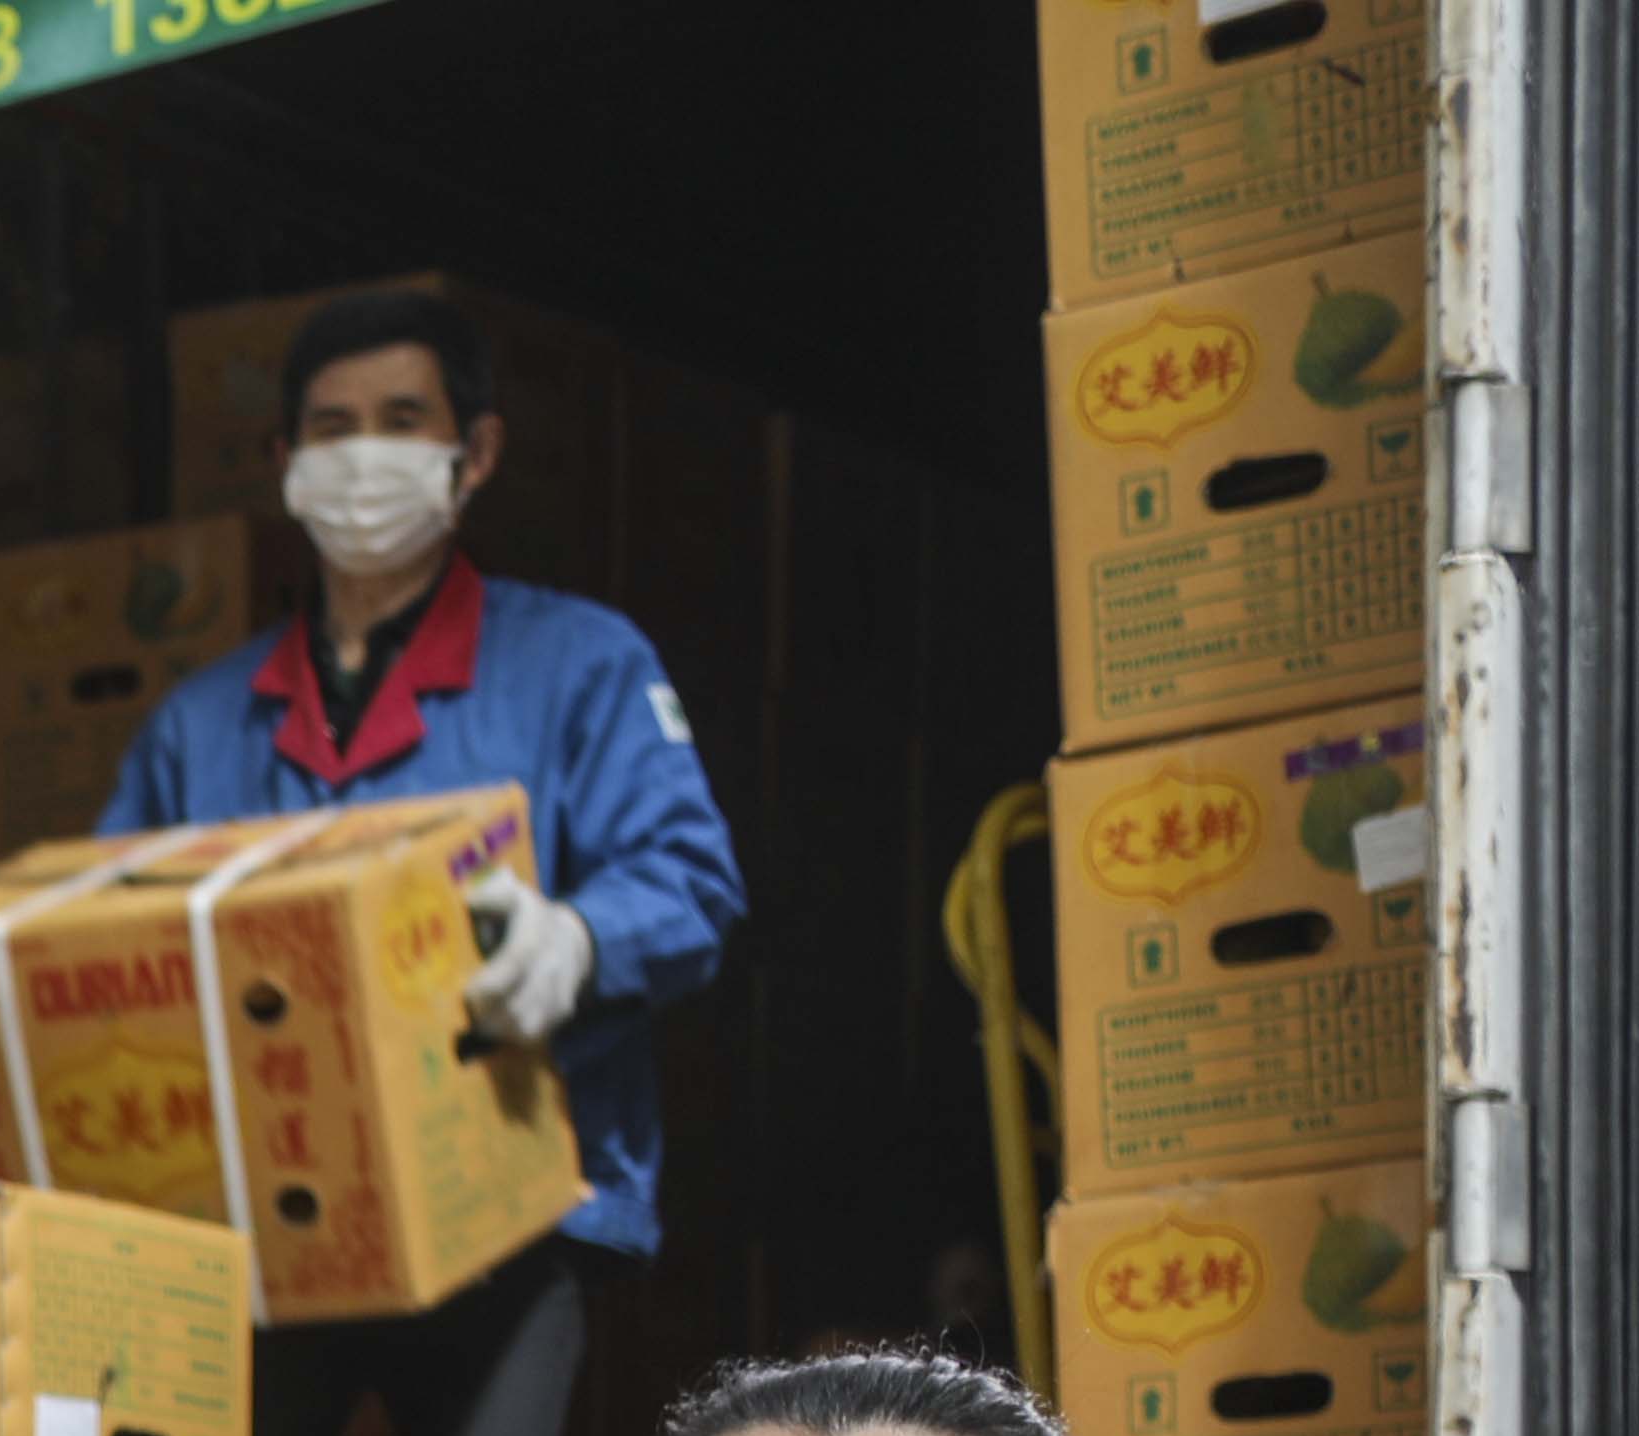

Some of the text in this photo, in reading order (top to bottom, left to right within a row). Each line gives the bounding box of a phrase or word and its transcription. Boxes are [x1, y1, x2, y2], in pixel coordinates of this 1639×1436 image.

[1095, 334, 1241, 413] 艾美鲜
[1101, 802, 1246, 867] 艾美鲜
[1103, 1252, 1251, 1313] 艾美鲜
